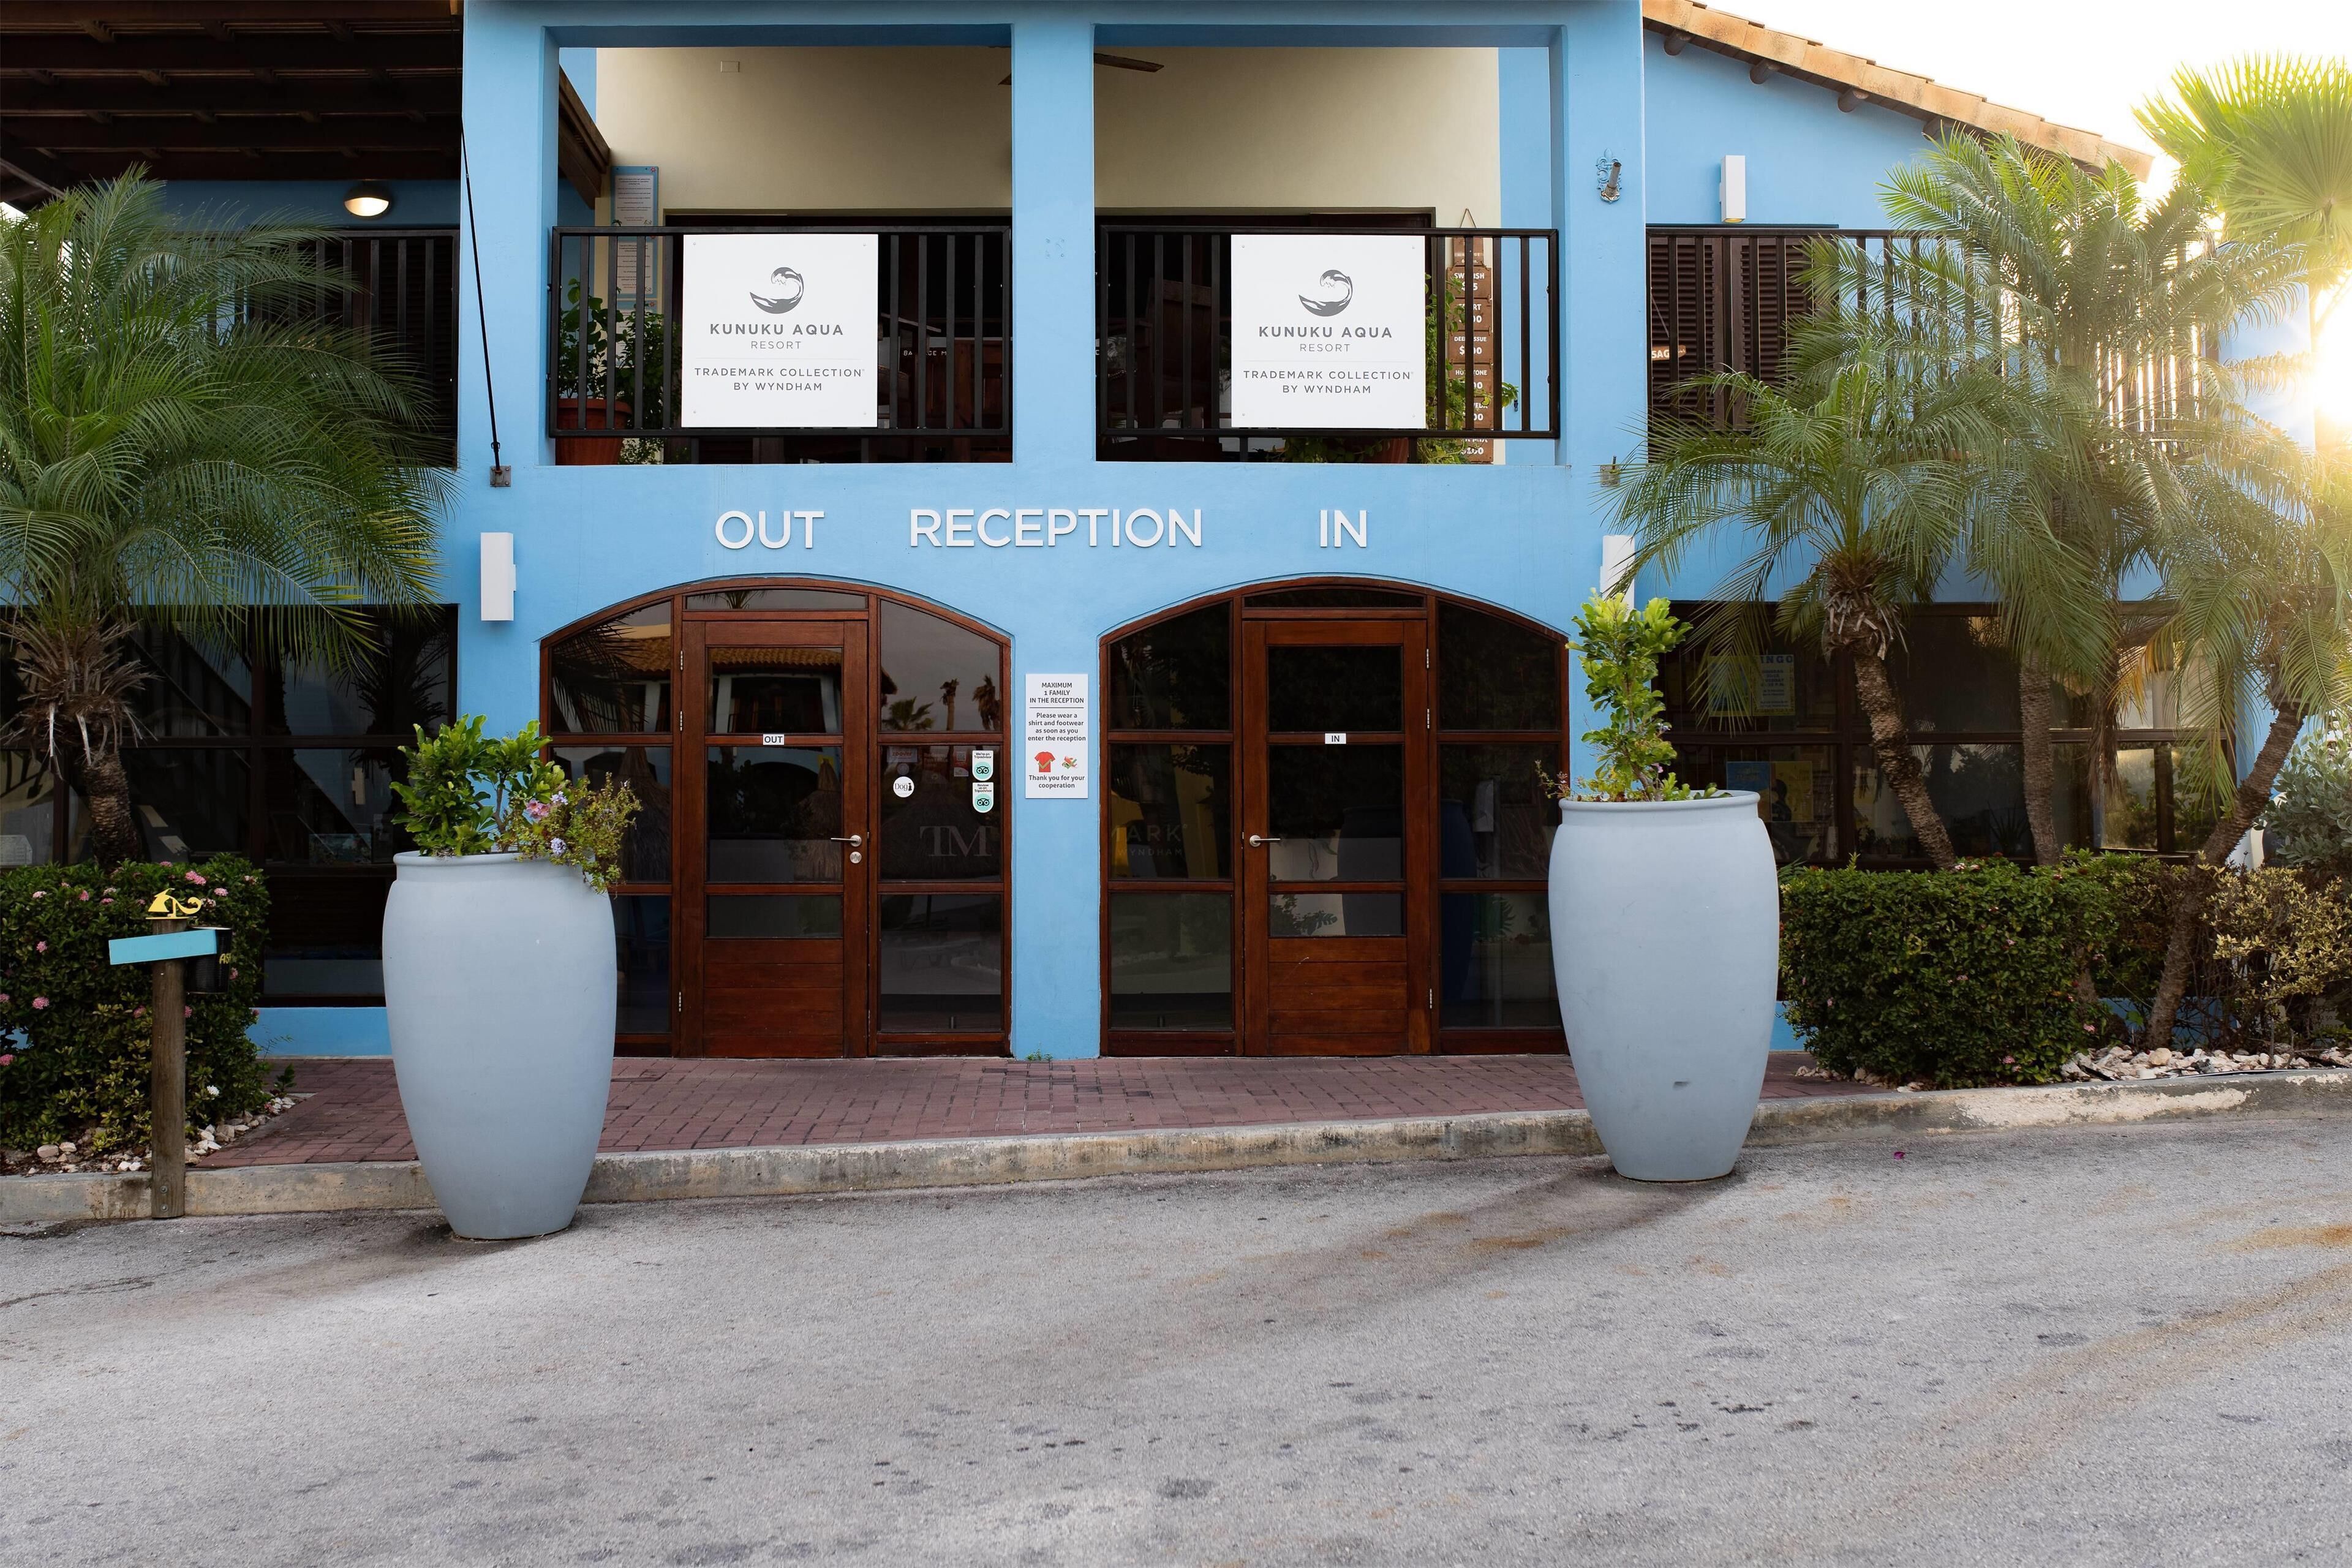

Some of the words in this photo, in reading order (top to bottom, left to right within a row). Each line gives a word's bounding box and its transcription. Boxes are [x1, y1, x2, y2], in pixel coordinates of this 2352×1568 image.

[710, 323, 783, 335] KUNUKU
[792, 324, 843, 336] AQUA
[1259, 326, 1332, 338] KUNUKU
[1341, 326, 1392, 338] AQUA
[751, 341, 802, 350] RESORT
[1300, 343, 1351, 352] RESORT
[694, 368, 774, 377] TRADEMARK
[1243, 370, 1323, 379] TRADEMARK
[734, 382, 749, 391] BY
[755, 382, 822, 391] WYNDHAM
[1283, 385, 1298, 393] BY
[1303, 385, 1371, 394] WYNDHAM
[715, 510, 825, 549] OUT
[910, 508, 1202, 548] RECEPTION
[1319, 510, 1368, 548] IN
[1117, 848, 1183, 856] WYNDHAM
